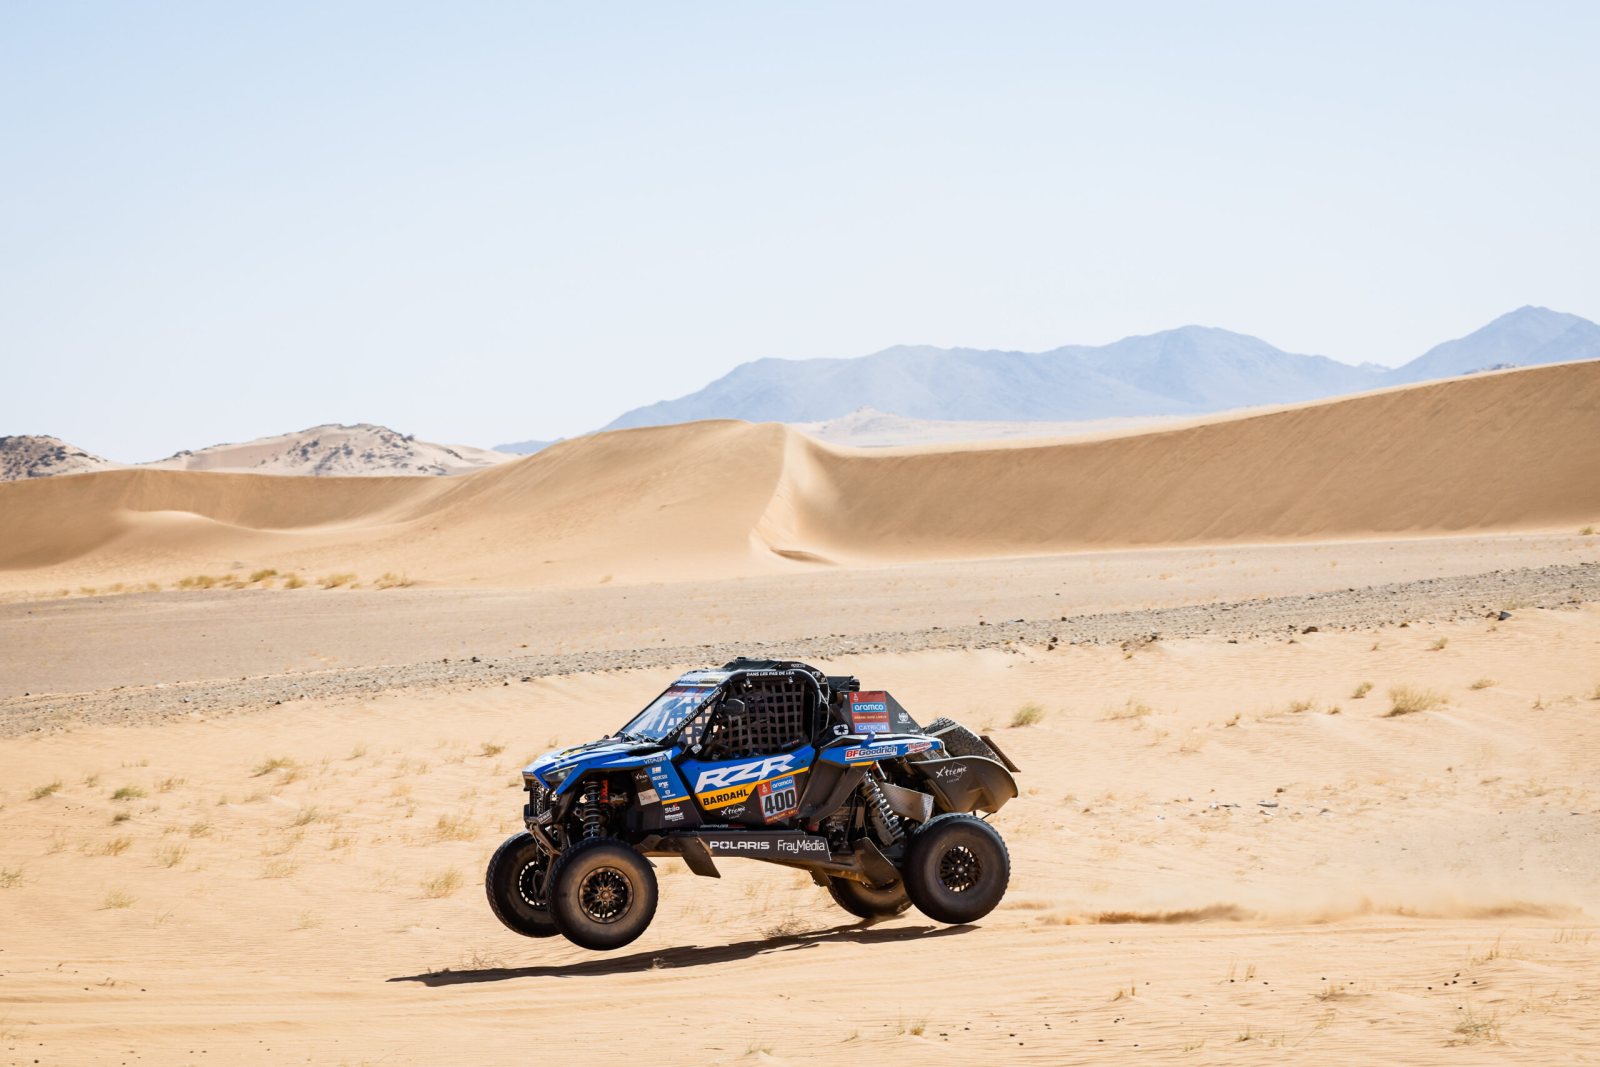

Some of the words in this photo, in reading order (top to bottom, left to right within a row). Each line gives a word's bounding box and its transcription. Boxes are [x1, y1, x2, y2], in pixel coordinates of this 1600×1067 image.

[854, 703, 884, 711] aramco
[846, 745, 898, 758] BFGoodrich
[694, 753, 796, 794] RZR
[771, 778, 793, 789] aramco
[702, 788, 750, 806] BARDAHL
[764, 789, 796, 815] 400
[709, 841, 771, 850] POLARIS
[777, 839, 826, 854] FrayMédia
